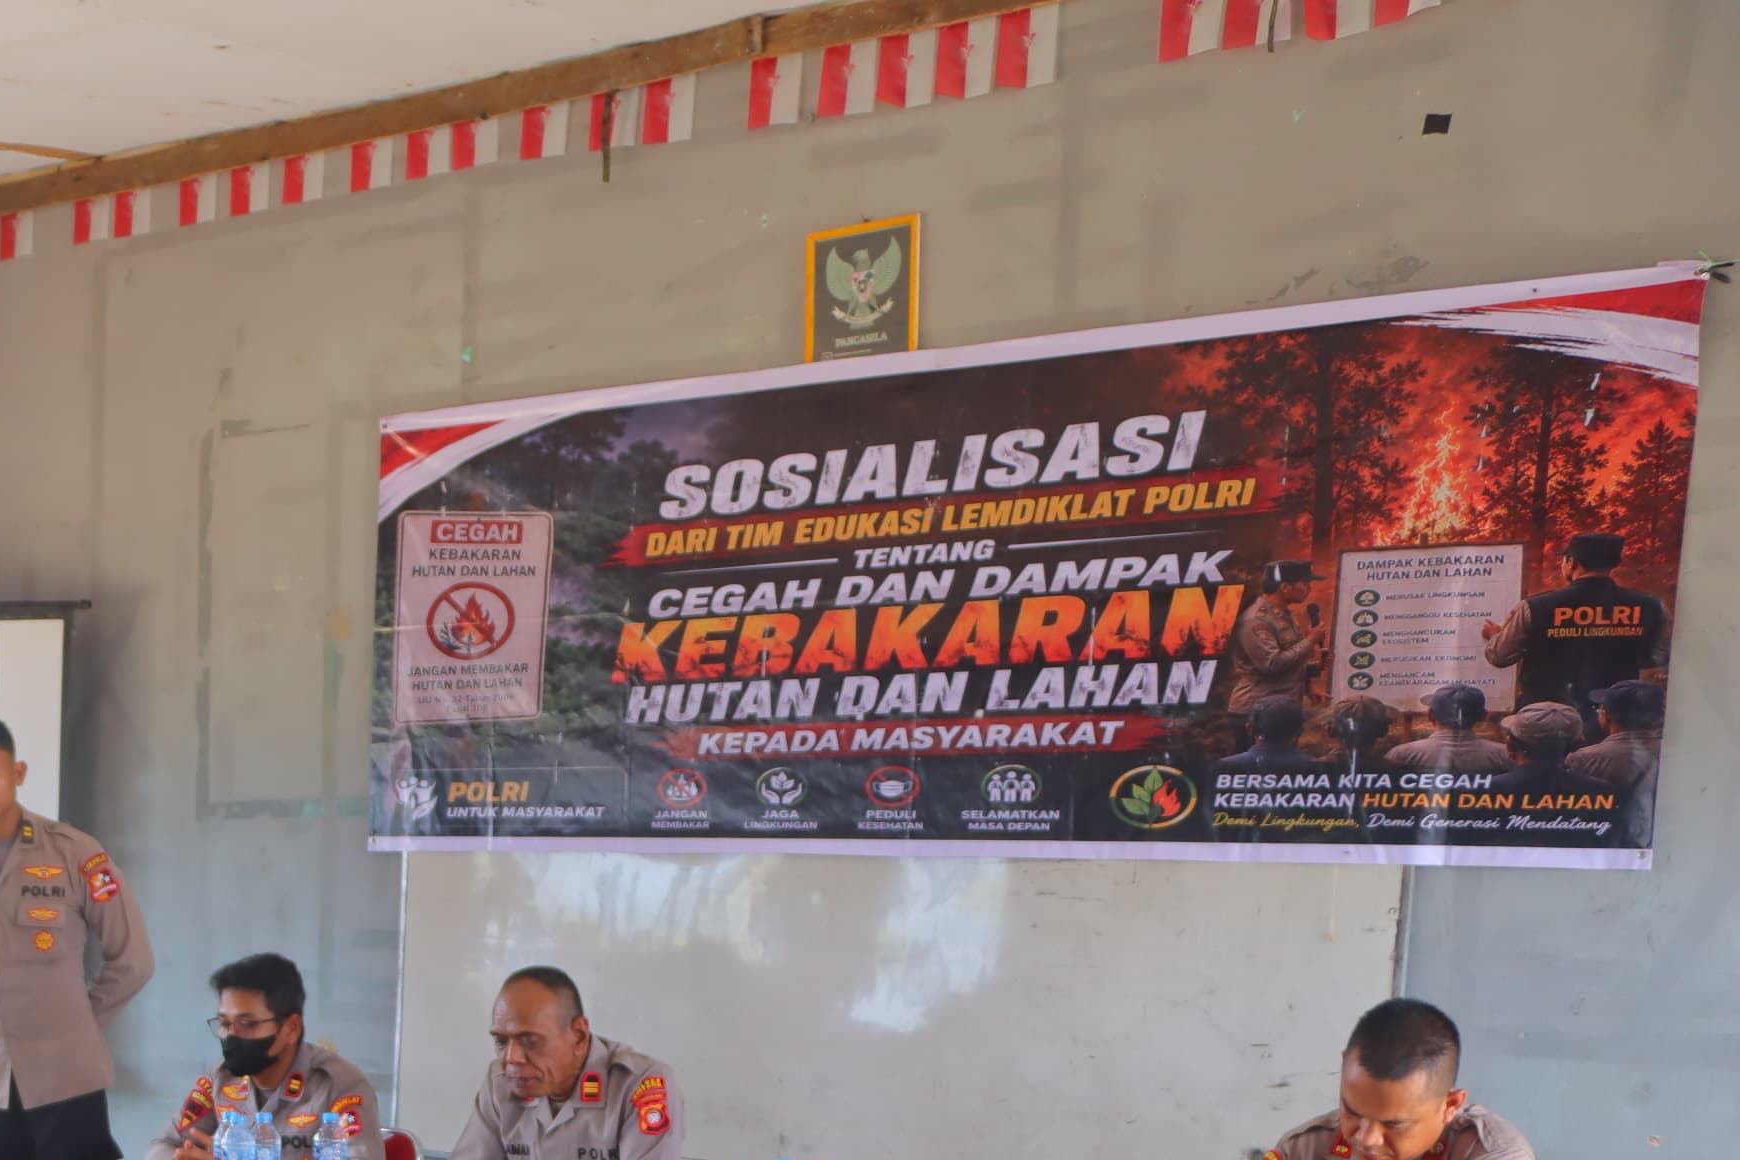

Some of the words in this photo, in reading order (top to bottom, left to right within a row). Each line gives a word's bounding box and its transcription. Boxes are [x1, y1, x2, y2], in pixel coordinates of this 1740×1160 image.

[659, 410, 1207, 520] SOSIALISASI
[646, 527, 717, 557] DARI
[726, 521, 785, 550] TIM
[794, 506, 935, 544] EDUKASI
[942, 488, 1136, 532] LEMDIKLAT
[1143, 478, 1257, 514] POLRI
[436, 522, 518, 542] CEGAH
[428, 547, 522, 561] KEBAKARAN
[853, 538, 996, 569] TENTANG
[1356, 557, 1413, 571] DAMPAK
[1417, 553, 1506, 567] KEBAKARAN
[411, 565, 456, 577] HUTAN
[460, 565, 489, 577] DAN
[493, 564, 537, 576] LAHAN
[1365, 569, 1410, 581] HUTAN
[1413, 568, 1442, 580] DAN
[1444, 566, 1493, 578] LAHAN
[648, 577, 822, 619] CEGAH
[834, 568, 956, 606] DAN
[968, 549, 1235, 598] DAMPAK
[1553, 605, 1642, 626] POLRI
[611, 584, 1245, 684] KEBAKARAN
[1547, 627, 1581, 639] PEDULI
[1583, 626, 1644, 638] LINGKUNGAN
[407, 664, 457, 677] JANGAN
[460, 662, 529, 675] MEMBAKAR
[411, 679, 453, 691] HUTAN
[456, 678, 481, 690] DAN
[484, 677, 523, 689] LAHAN
[625, 677, 821, 724] HUTAN
[835, 671, 969, 717] DAN
[985, 660, 1217, 711] LAHAN
[697, 729, 840, 756] KEPADA
[850, 720, 1126, 751] MASYARAKAT
[1215, 773, 1331, 790] BERSAMA
[1337, 773, 1393, 790] KITA
[1398, 773, 1493, 790] CEGAH
[446, 779, 531, 802] POLRI
[1213, 792, 1356, 809] KEBAKARAN
[1362, 792, 1450, 809] HUTAN
[1458, 793, 1514, 810] DAN
[1520, 793, 1614, 811] LAHAN
[446, 805, 497, 818] UNTUK
[501, 805, 606, 818] MASYARAKAT
[654, 809, 708, 819] JANGAN
[760, 809, 800, 820] JAGA
[865, 809, 917, 820] PEDULI
[961, 809, 1061, 821] SELAMATKAN
[651, 820, 711, 830] MEMBAKAR
[743, 820, 819, 831] LINGKUNGAN
[857, 820, 924, 831] KESEHATAN
[967, 821, 1005, 832] MASA
[1007, 821, 1051, 832] DEPAN
[1212, 811, 1256, 828] Demi
[1259, 811, 1361, 832] Lingkungan,
[1366, 812, 1415, 829] Demi
[1420, 812, 1502, 830] Generasi
[1505, 813, 1613, 836] Mendatang
[21, 885, 67, 898] POLRI
[282, 1136, 311, 1149] POL
[577, 1146, 620, 1160] POLR
